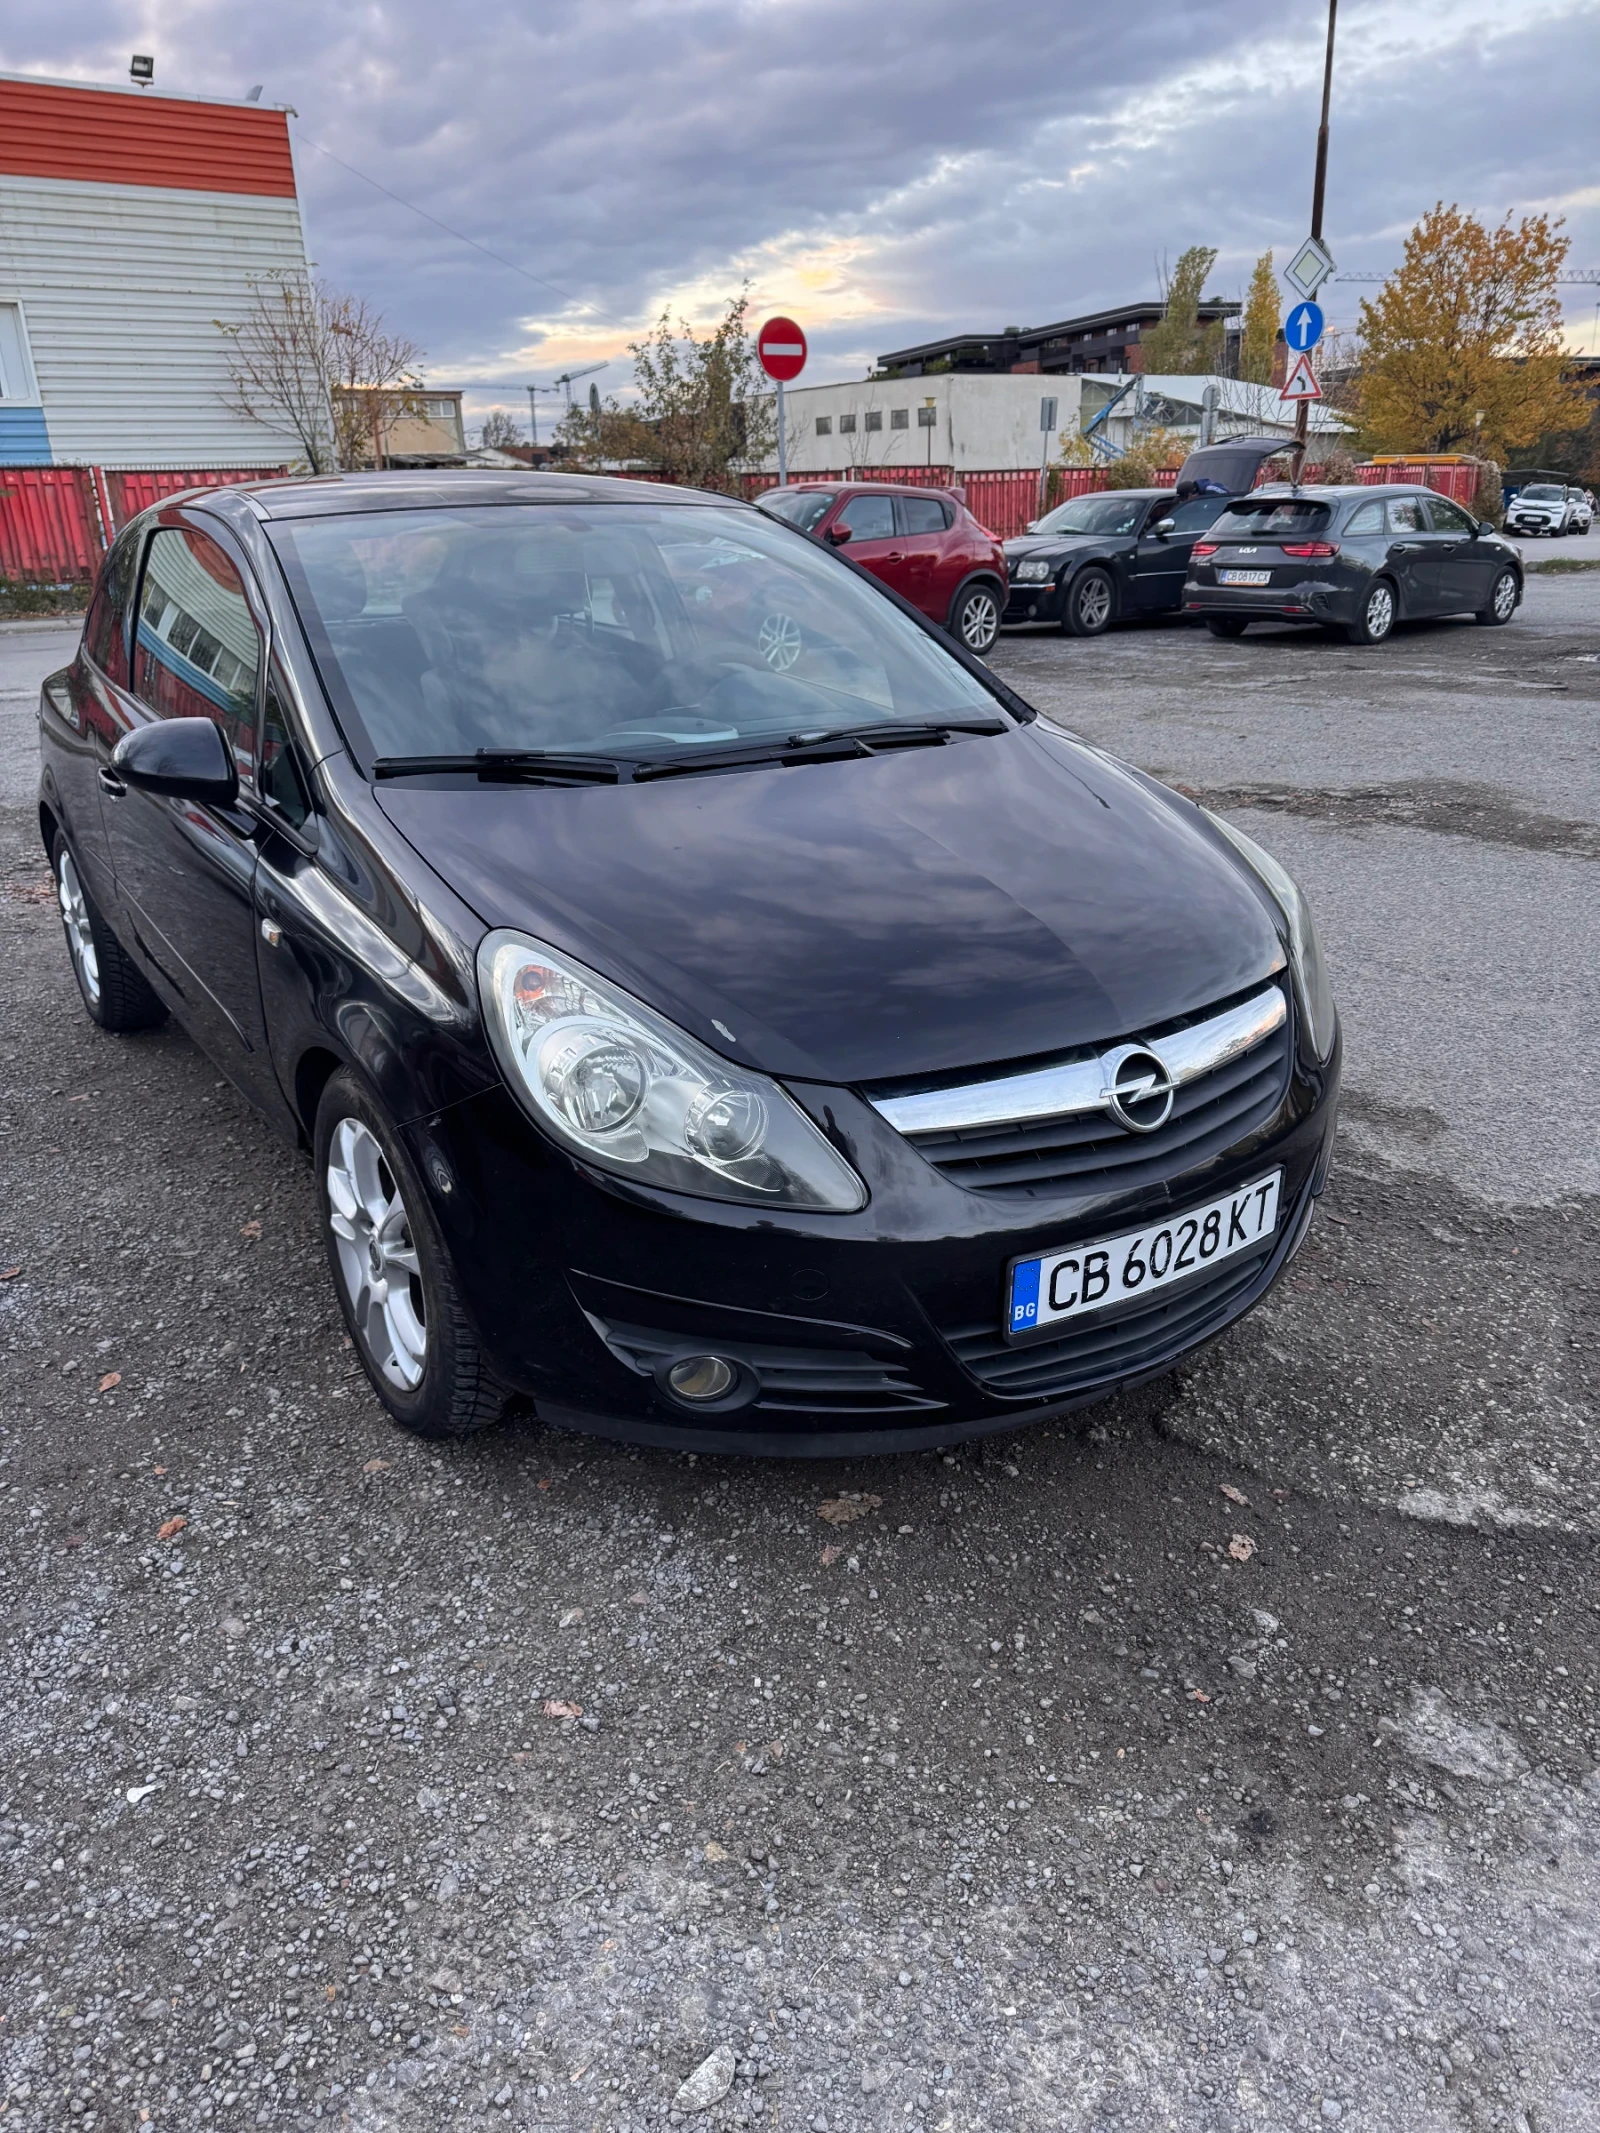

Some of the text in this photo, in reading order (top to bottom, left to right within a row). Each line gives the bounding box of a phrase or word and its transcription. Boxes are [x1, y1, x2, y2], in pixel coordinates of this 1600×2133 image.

[1227, 572, 1237, 581] CB
[1258, 573, 1269, 582] CX
[1048, 1181, 1275, 1311] CB 6028 KT
[1014, 1302, 1036, 1322] BG
